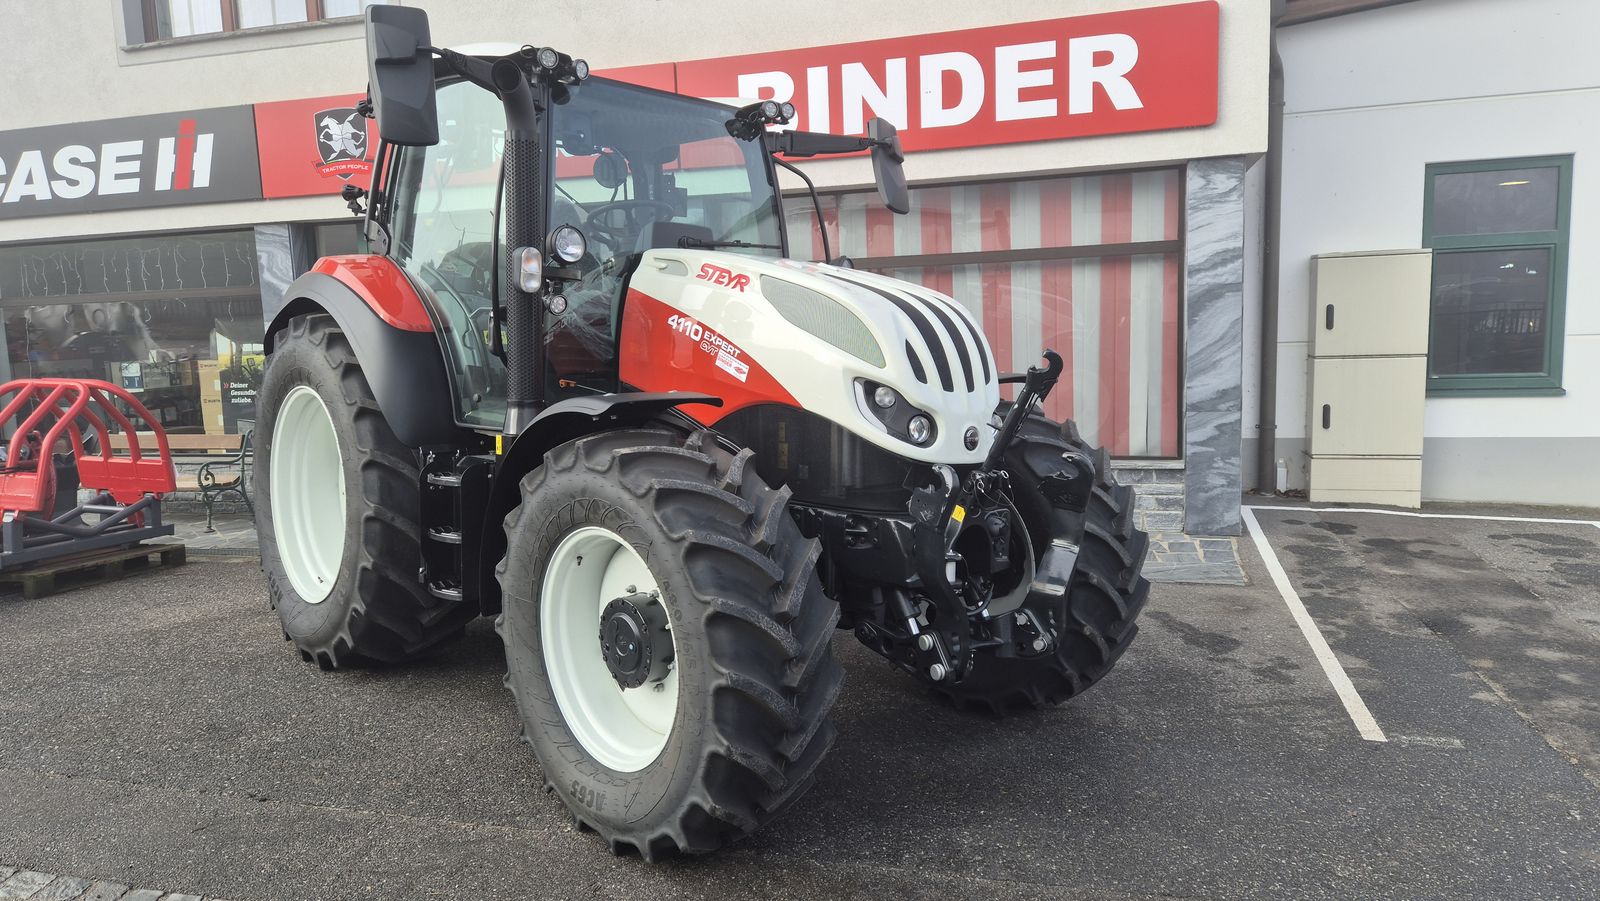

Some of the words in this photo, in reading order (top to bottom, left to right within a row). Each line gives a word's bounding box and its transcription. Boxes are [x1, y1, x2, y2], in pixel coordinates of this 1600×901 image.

[737, 33, 1144, 136] BINDER
[0, 140, 144, 203] ASE
[322, 164, 346, 173] TRACTOR
[696, 263, 750, 293] STEYR
[667, 314, 703, 342] 4110
[703, 331, 741, 358] EXPERT
[700, 340, 719, 356] CVT
